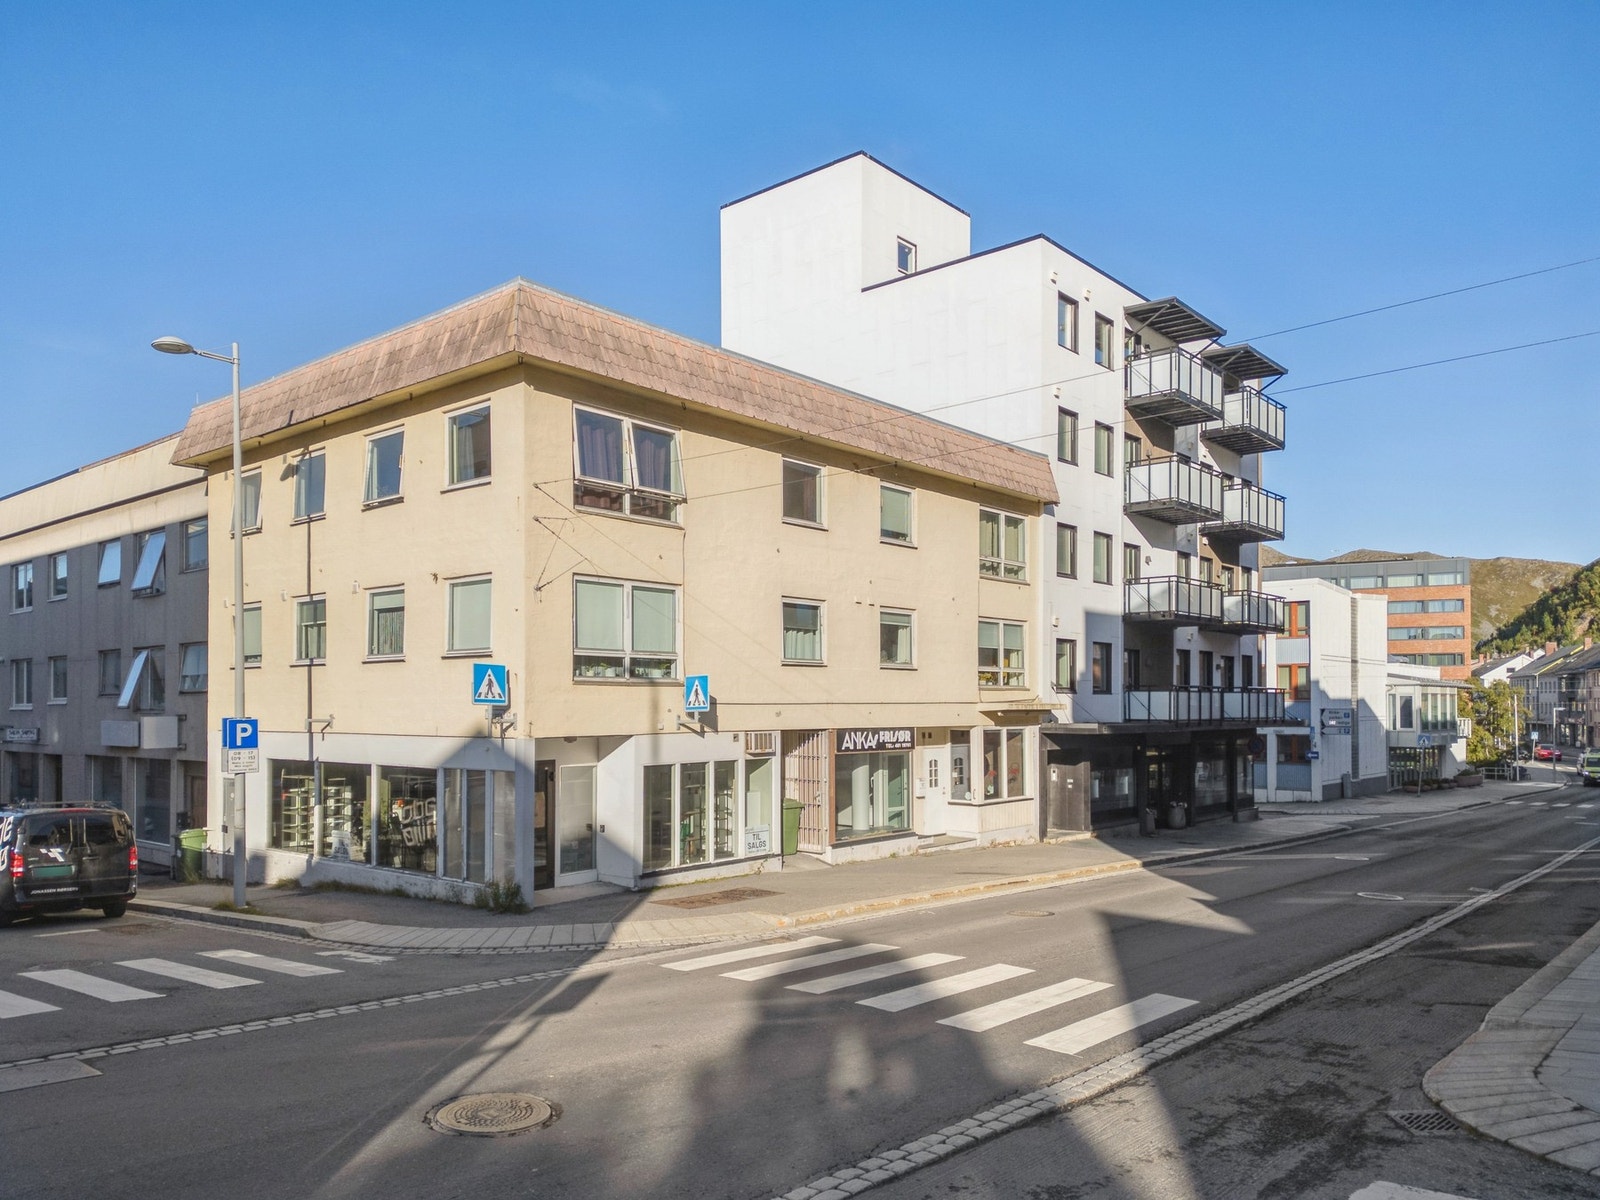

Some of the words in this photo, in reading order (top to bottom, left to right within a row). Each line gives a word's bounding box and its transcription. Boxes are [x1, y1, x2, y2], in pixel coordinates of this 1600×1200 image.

[236, 723, 252, 746] P
[879, 730, 911, 743] FRISØR
[747, 840, 766, 849] SALGS
